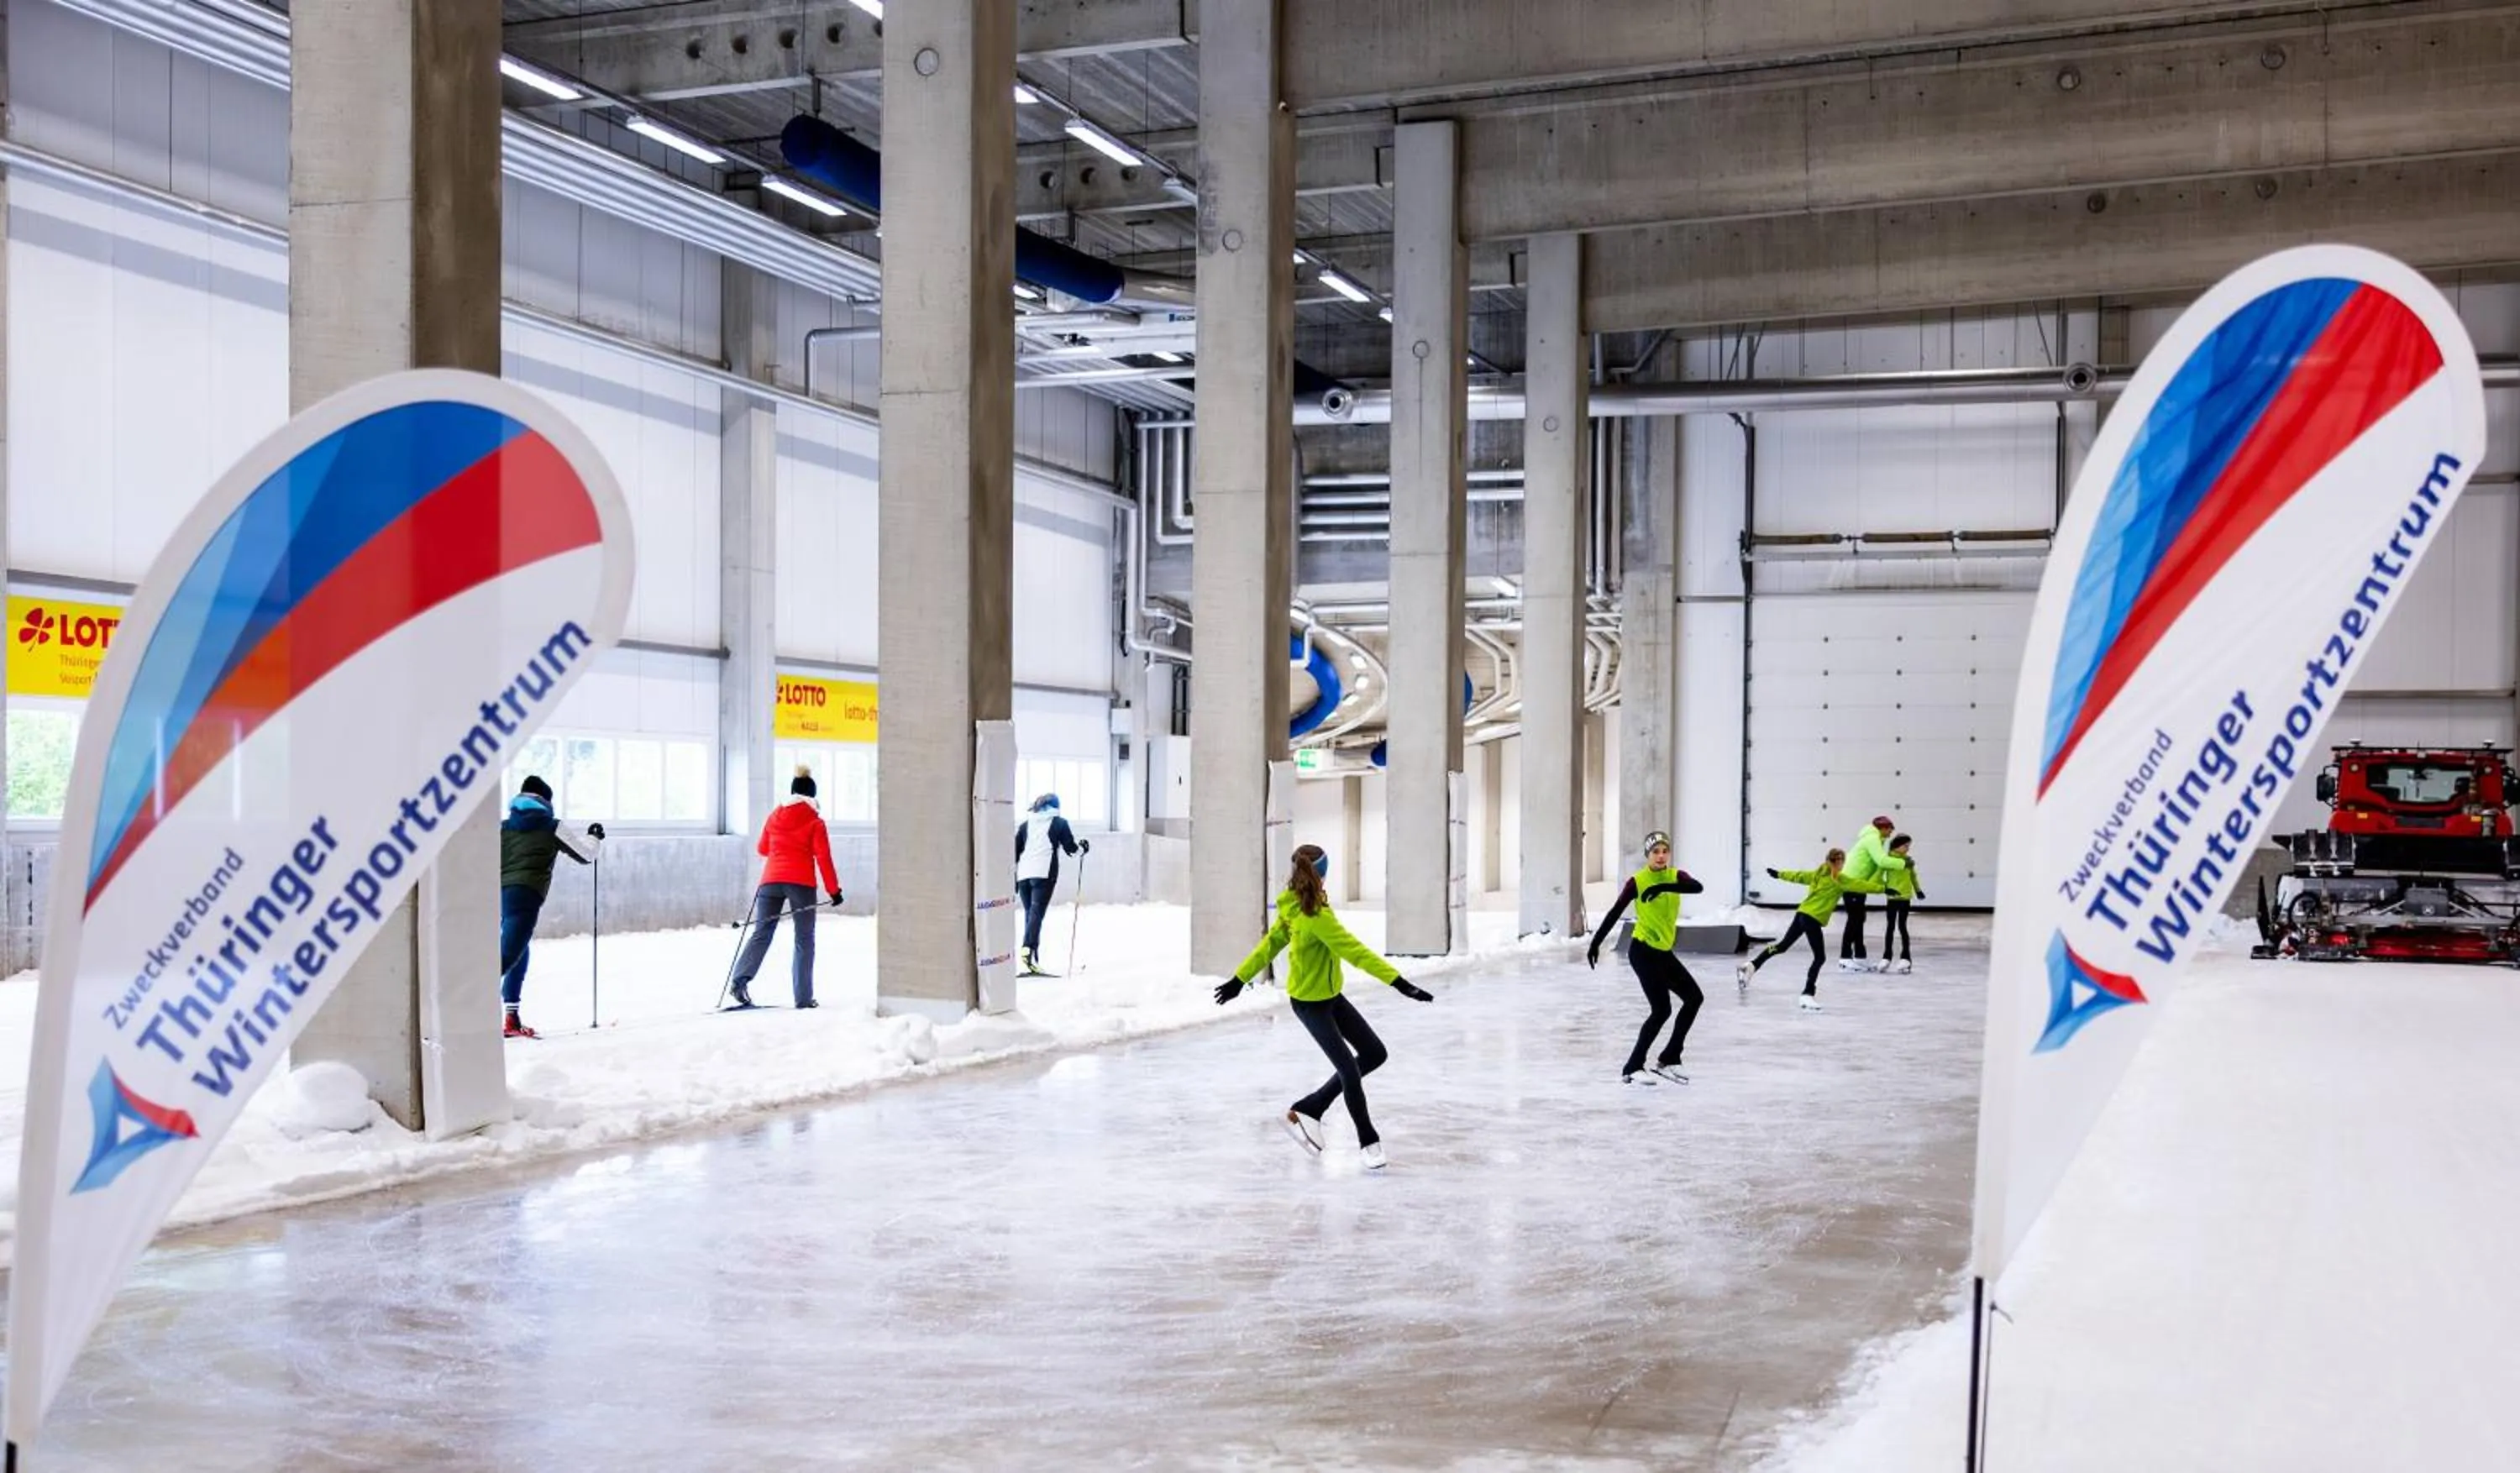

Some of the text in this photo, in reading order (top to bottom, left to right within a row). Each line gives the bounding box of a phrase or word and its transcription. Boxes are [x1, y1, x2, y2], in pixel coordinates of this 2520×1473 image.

[60, 614, 120, 648] LOT
[785, 683, 826, 707] LOTTO
[2135, 452, 2463, 964] Wintersportzentrum
[192, 620, 593, 1098] Wintersportzentrum
[2058, 728, 2173, 904] Zweckverband
[2085, 689, 2255, 933] Thüringer
[102, 847, 244, 1031] Zweckverband
[136, 815, 339, 1066] Thüringer
